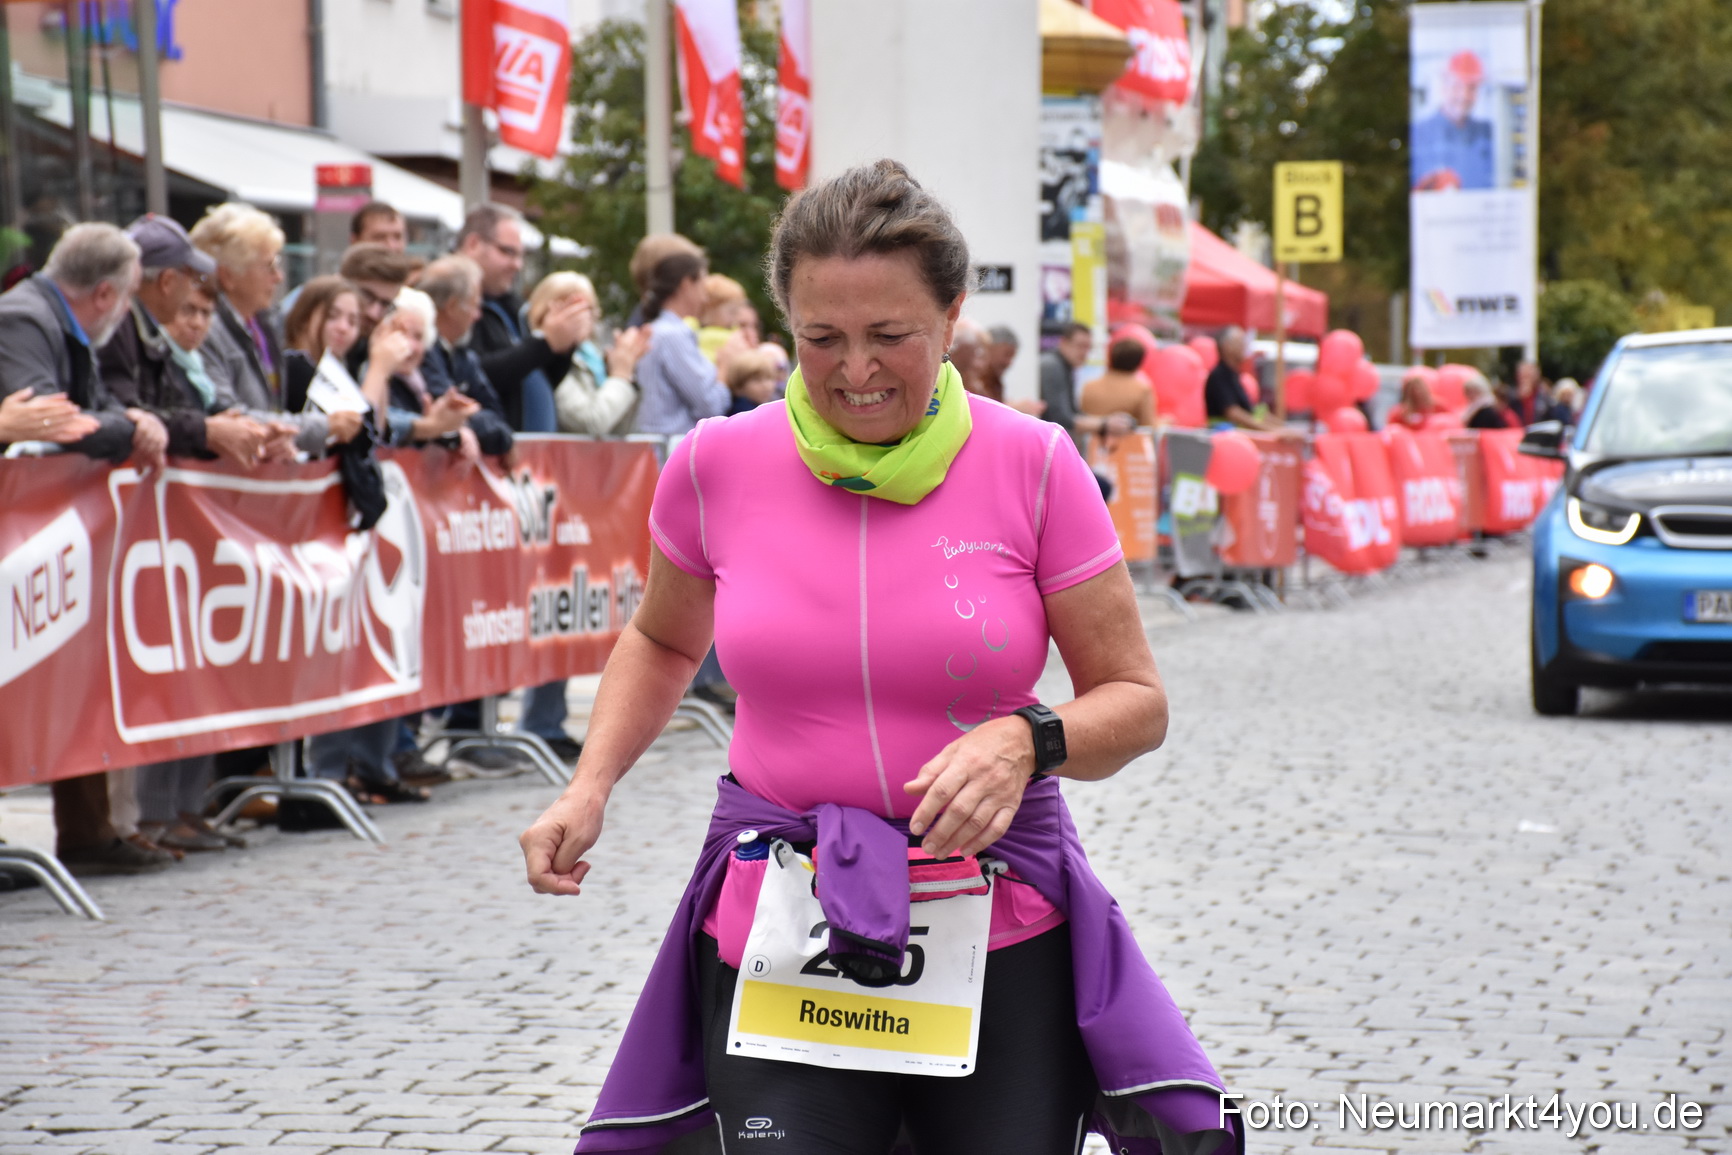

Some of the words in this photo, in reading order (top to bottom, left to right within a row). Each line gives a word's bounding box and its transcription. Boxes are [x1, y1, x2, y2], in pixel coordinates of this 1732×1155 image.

[1295, 194, 1324, 238] B
[12, 543, 77, 650] NEUE
[754, 960, 764, 973] D
[800, 921, 930, 987] 25
[799, 999, 910, 1035] Roswitha
[738, 1129, 785, 1140] Kalenji
